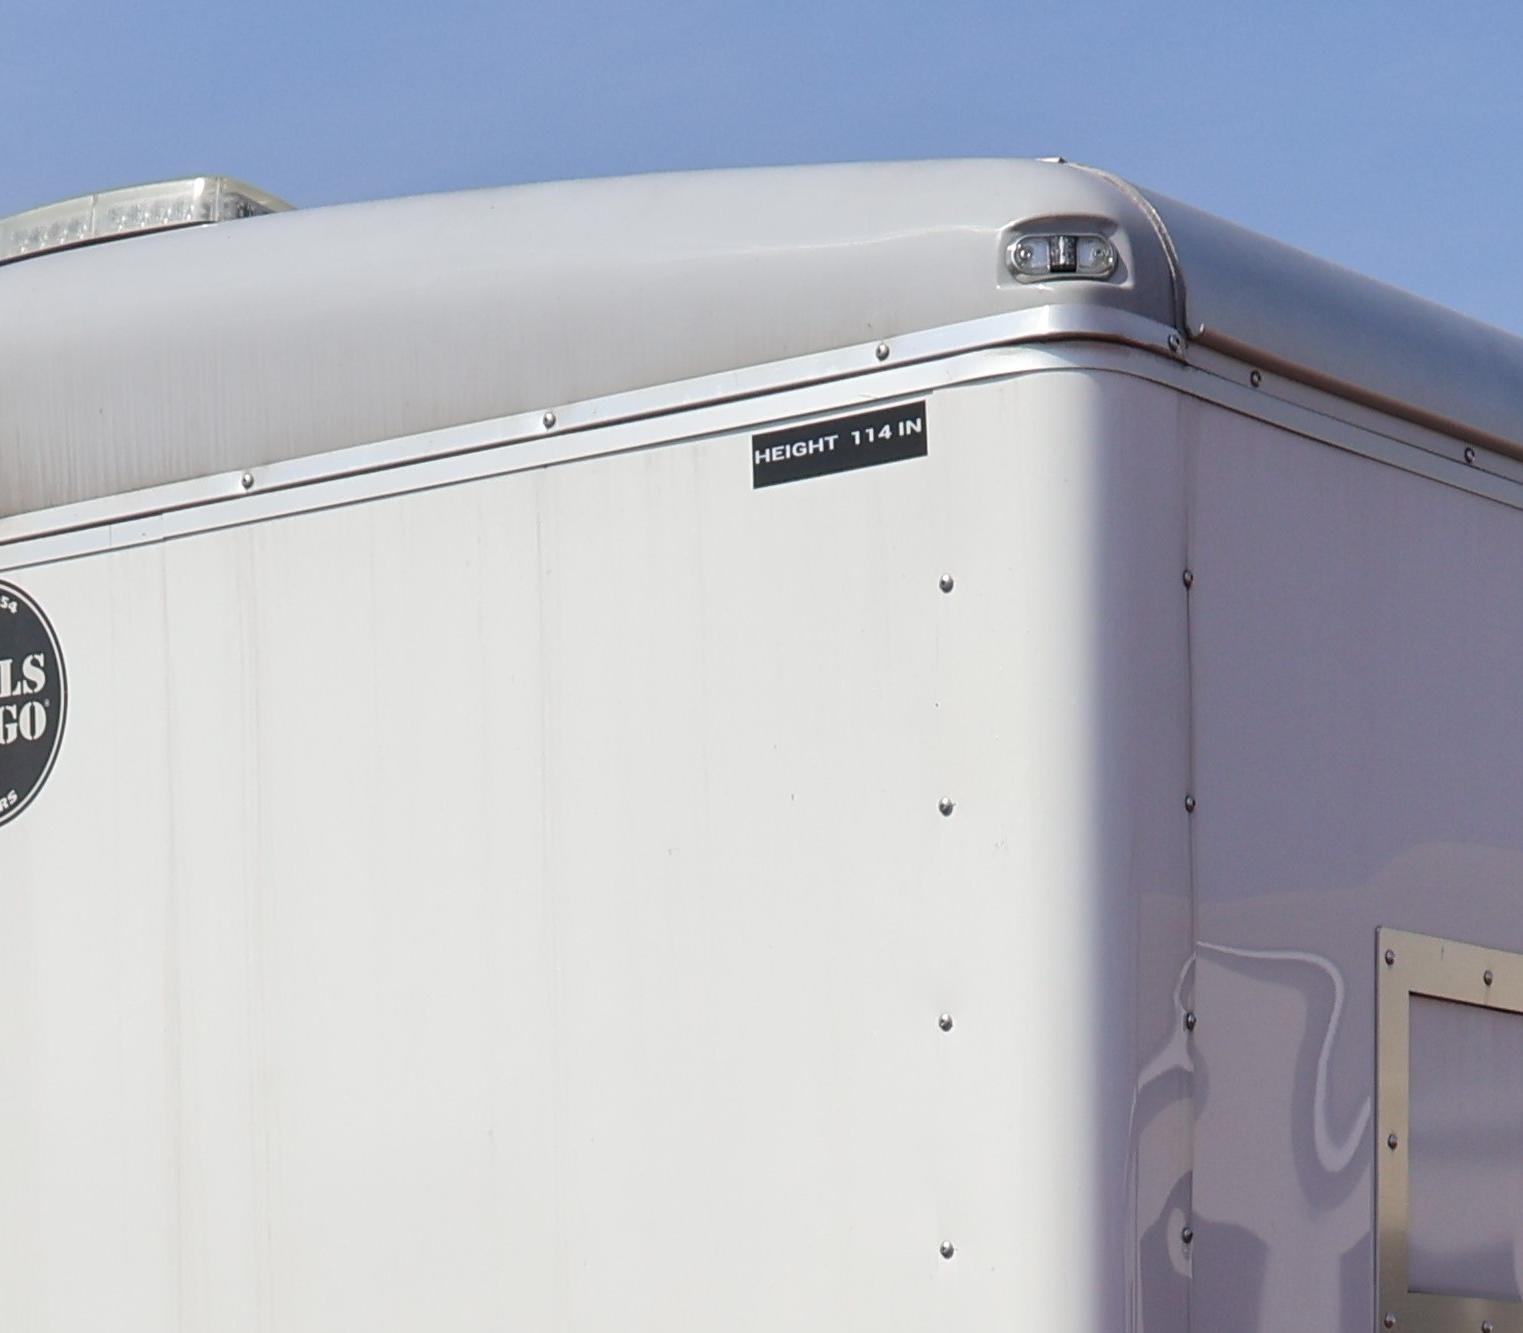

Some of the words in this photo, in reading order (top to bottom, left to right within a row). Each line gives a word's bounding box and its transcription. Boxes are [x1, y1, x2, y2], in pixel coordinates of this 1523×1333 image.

[754, 435, 839, 465] HEIGHT
[851, 424, 892, 446] 114
[898, 417, 922, 436] IN
